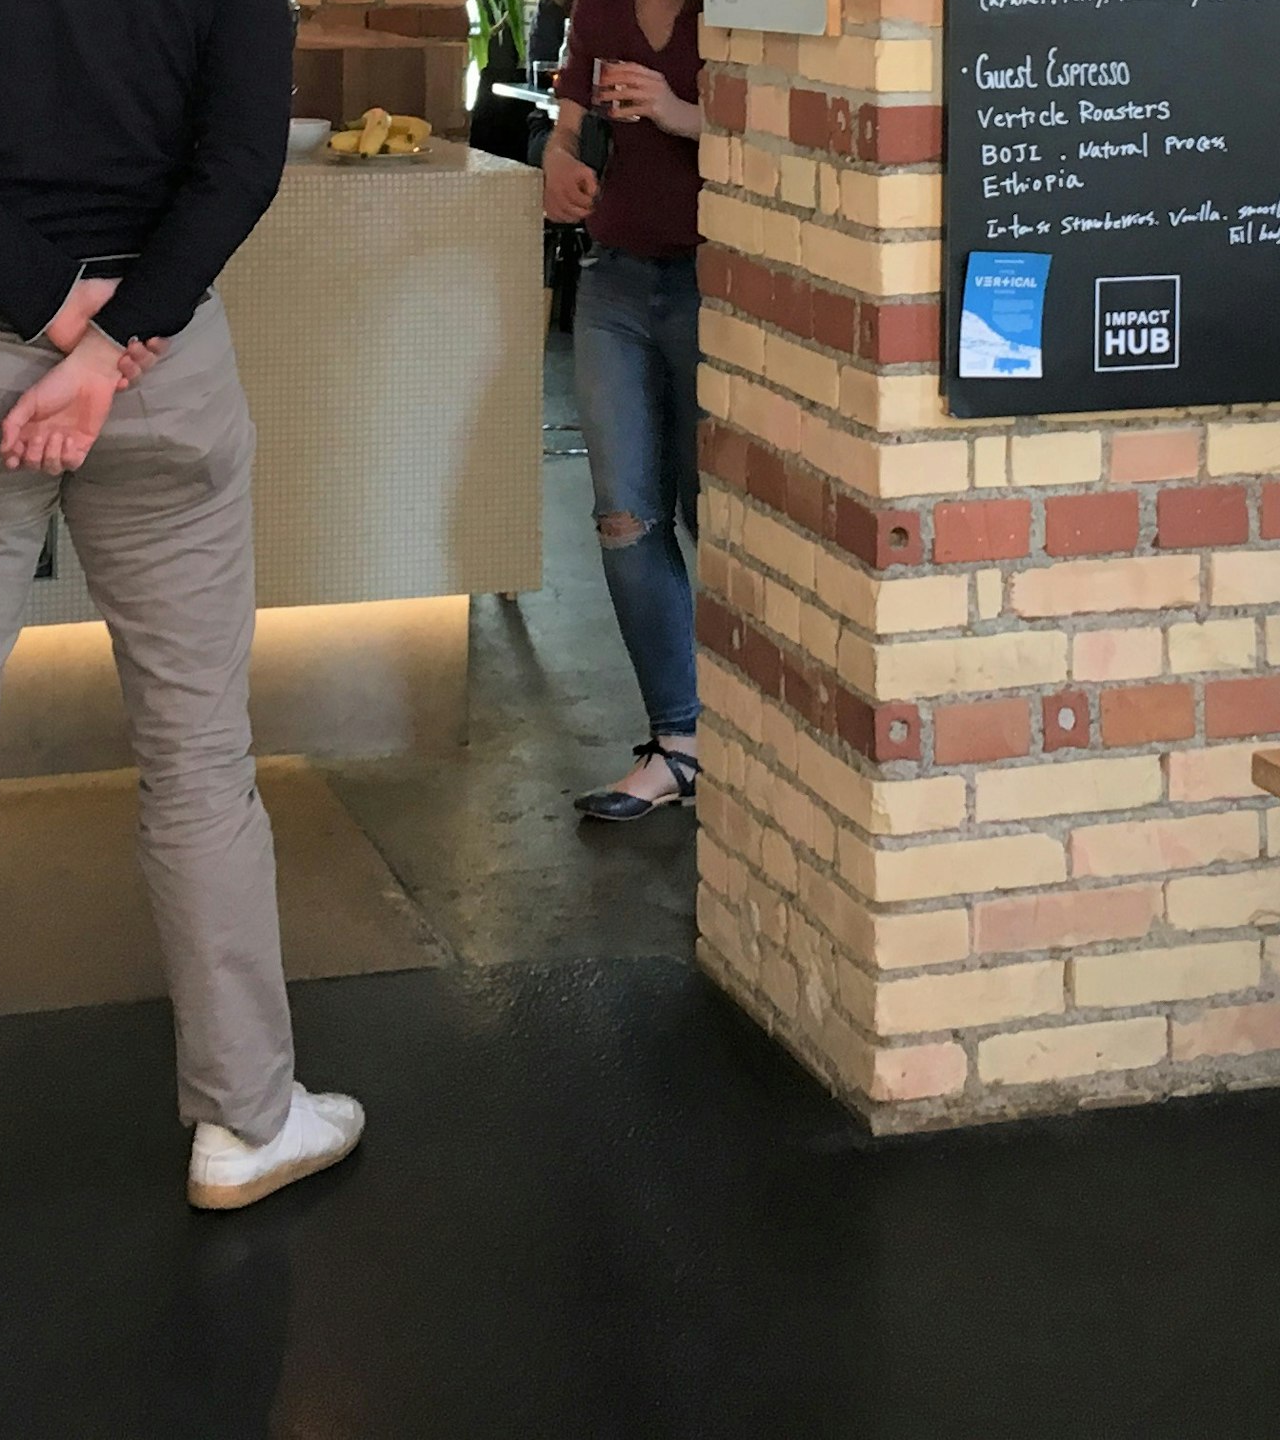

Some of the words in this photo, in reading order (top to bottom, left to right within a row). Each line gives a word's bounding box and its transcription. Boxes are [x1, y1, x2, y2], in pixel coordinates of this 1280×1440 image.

[976, 53, 1038, 90] Guest
[1046, 47, 1131, 88] Espresso
[1079, 100, 1171, 123] Roasters
[1079, 132, 1148, 159] Natural
[983, 169, 1084, 198] Ethiopia
[1105, 309, 1170, 327] IMPACT
[1105, 329, 1171, 356] HUB
